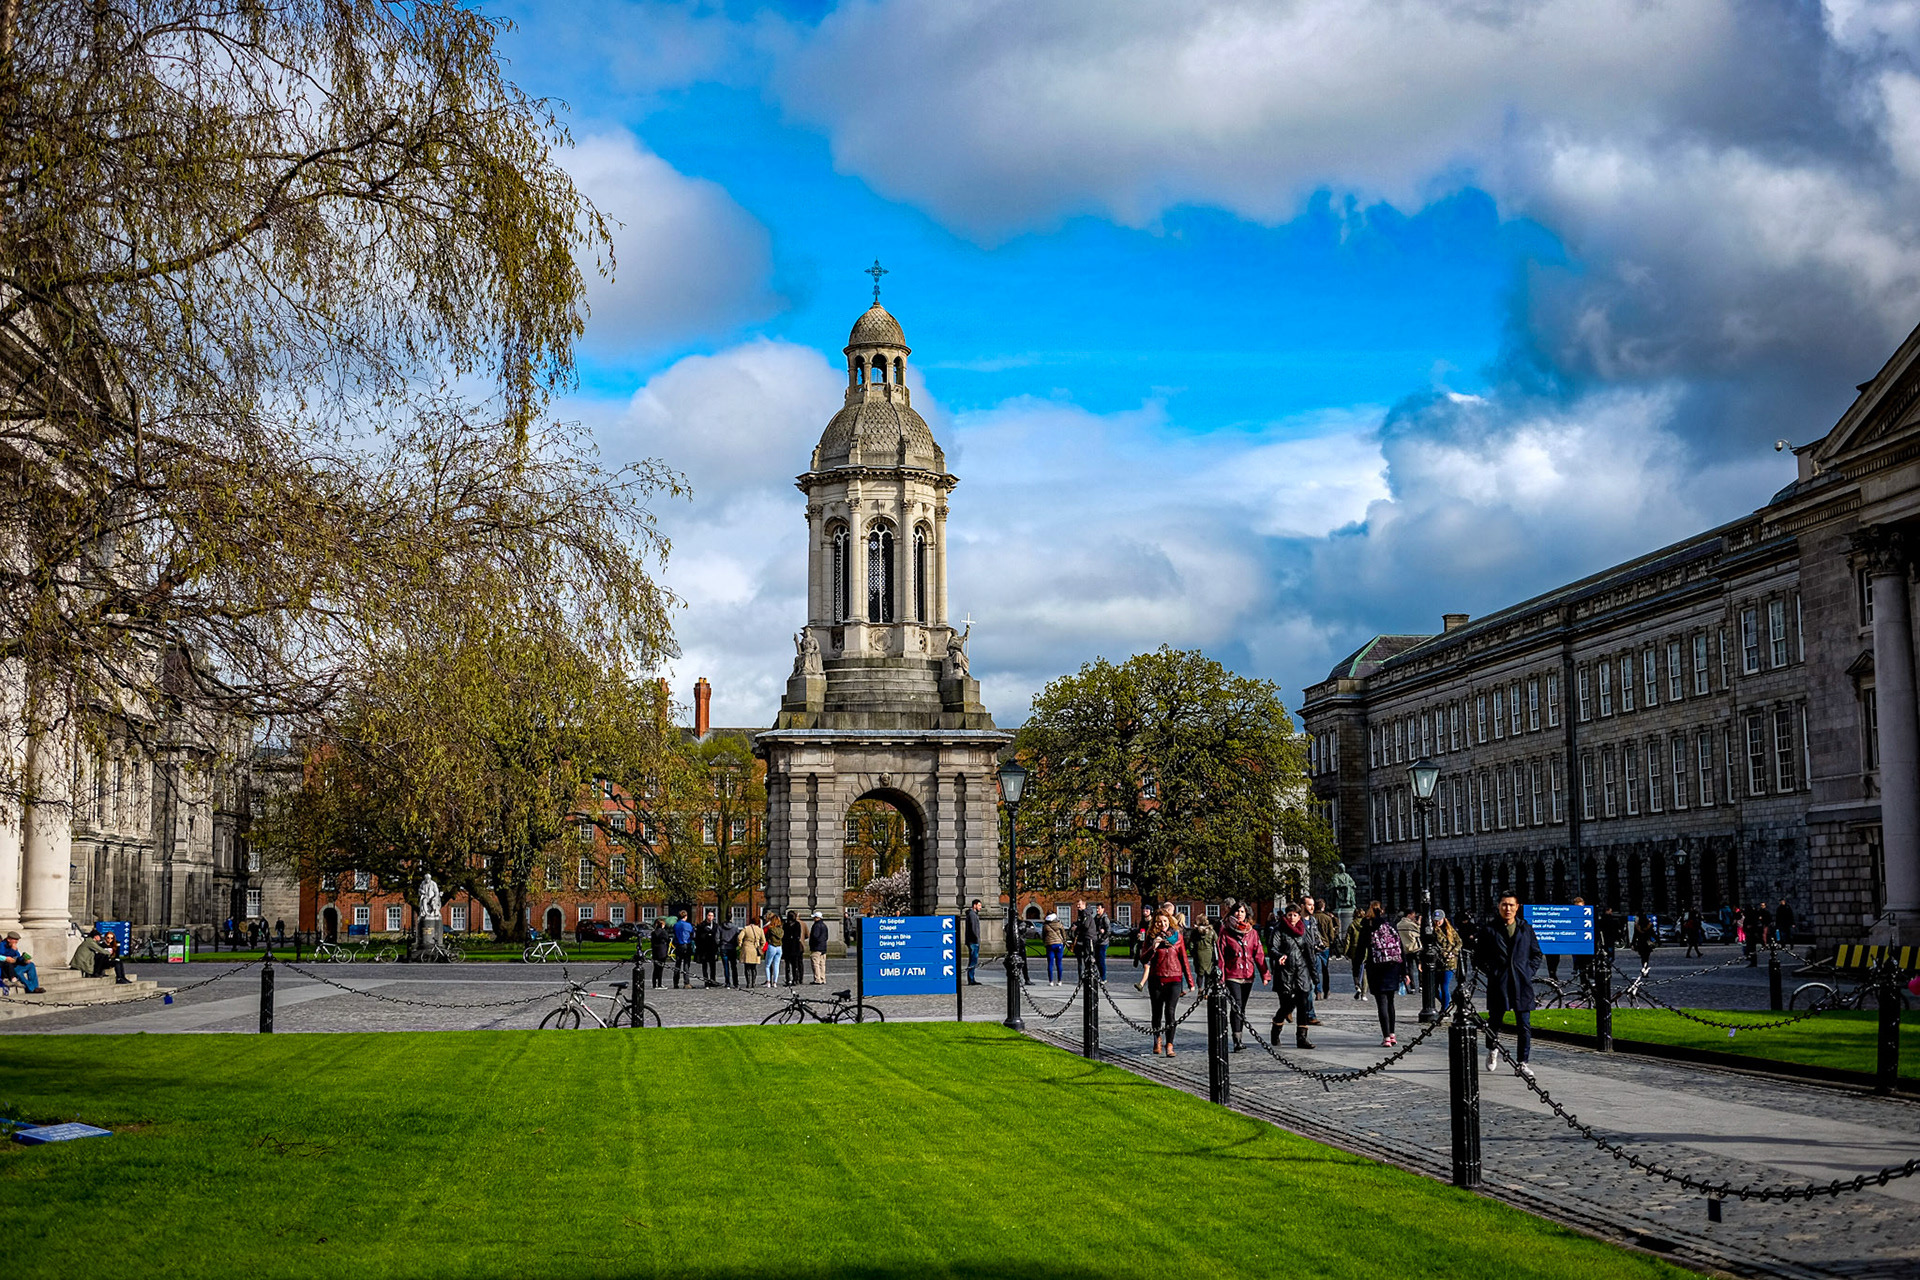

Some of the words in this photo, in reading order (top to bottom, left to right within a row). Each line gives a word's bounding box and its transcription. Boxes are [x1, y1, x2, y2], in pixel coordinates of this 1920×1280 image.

[879, 952, 901, 960] GMB
[880, 968, 901, 976] UMB
[902, 968, 906, 976] /
[906, 967, 926, 976] ATM
